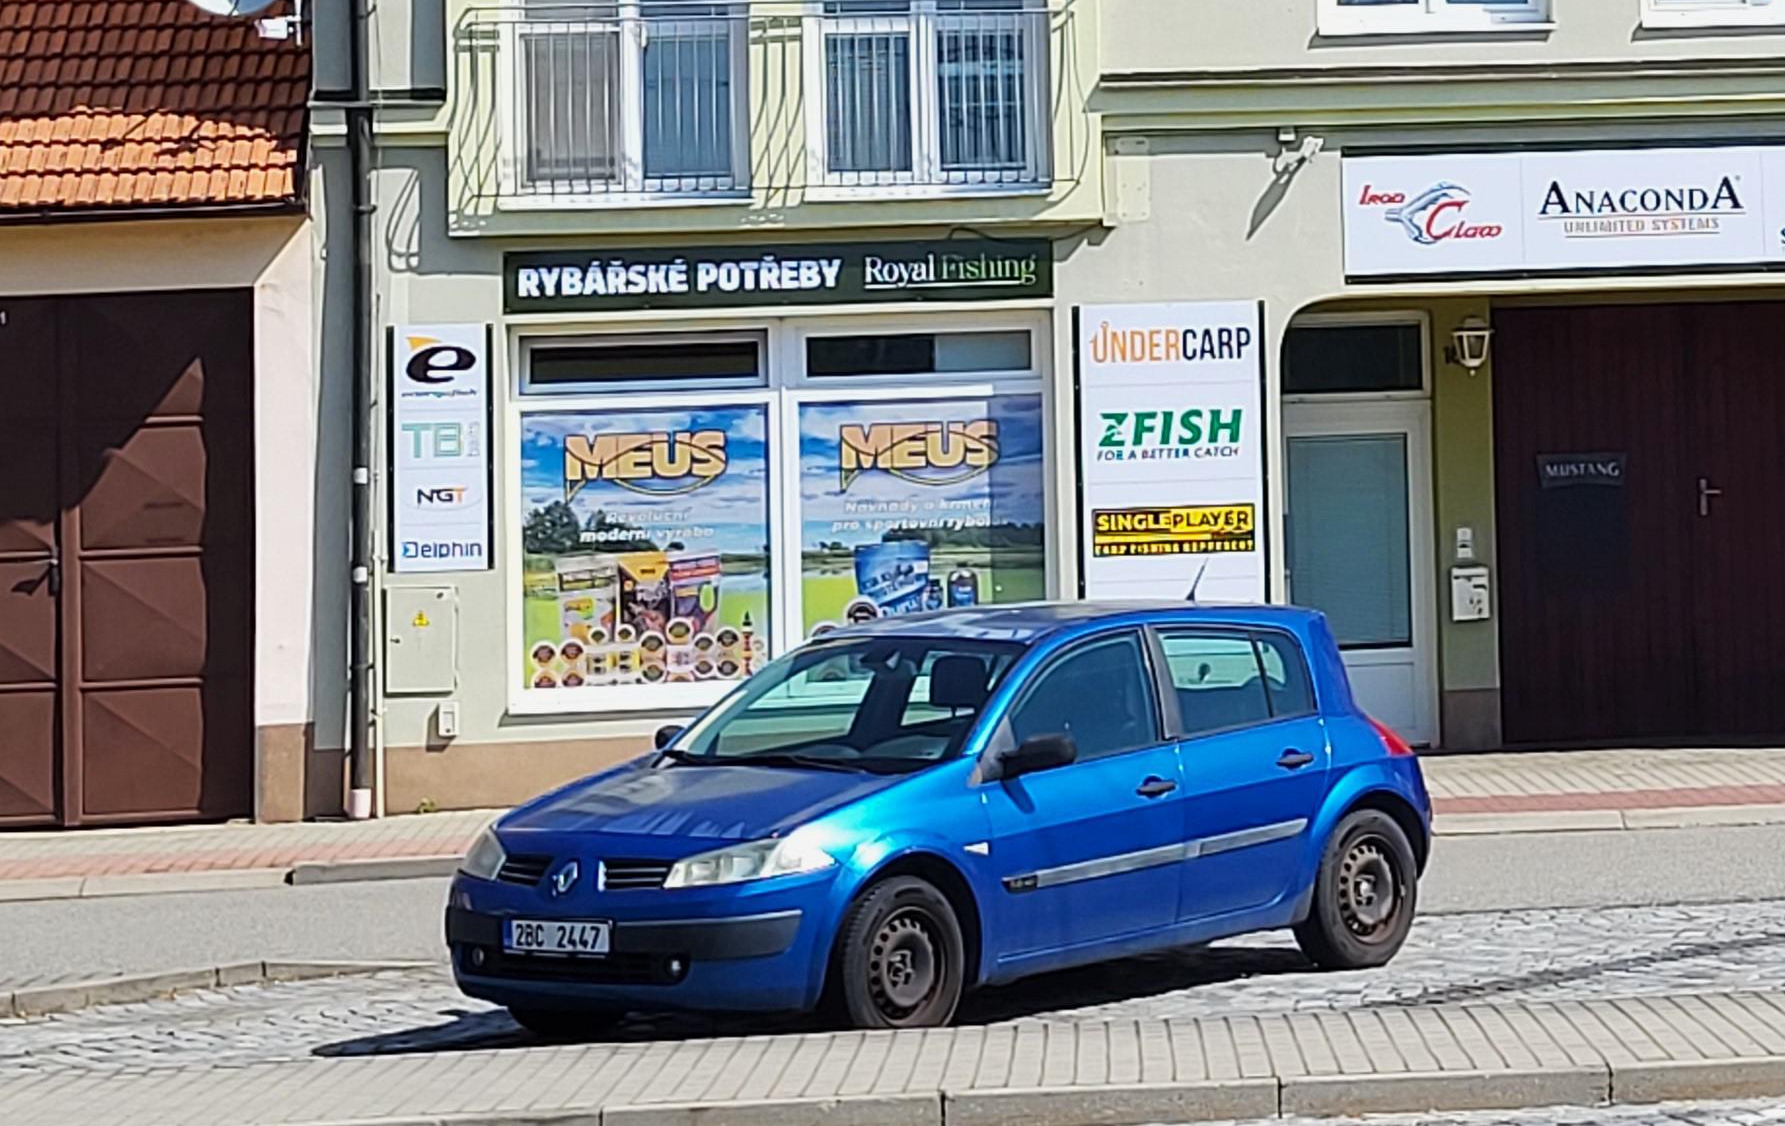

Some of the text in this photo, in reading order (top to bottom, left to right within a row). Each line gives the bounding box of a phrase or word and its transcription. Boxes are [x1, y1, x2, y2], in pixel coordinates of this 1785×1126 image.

[1563, 216, 1720, 234] UNLIMITED SYSTEMS
[517, 251, 1037, 298] RYBÁŘSKÉ POTŘEBY Royal Fishing
[1089, 321, 1252, 363] UNDERCARP
[1098, 408, 1244, 448] ZFISH
[564, 429, 729, 481] MEUS
[840, 419, 1000, 471] MEUS
[1096, 445, 1240, 461] FOR A BETTER CATCH
[1544, 461, 1620, 477] MUSTANG
[416, 487, 468, 507] NGT
[1096, 510, 1250, 531] SINGLEPLAYER
[401, 541, 482, 560] Delphin
[515, 923, 601, 951] 2BC 2447
